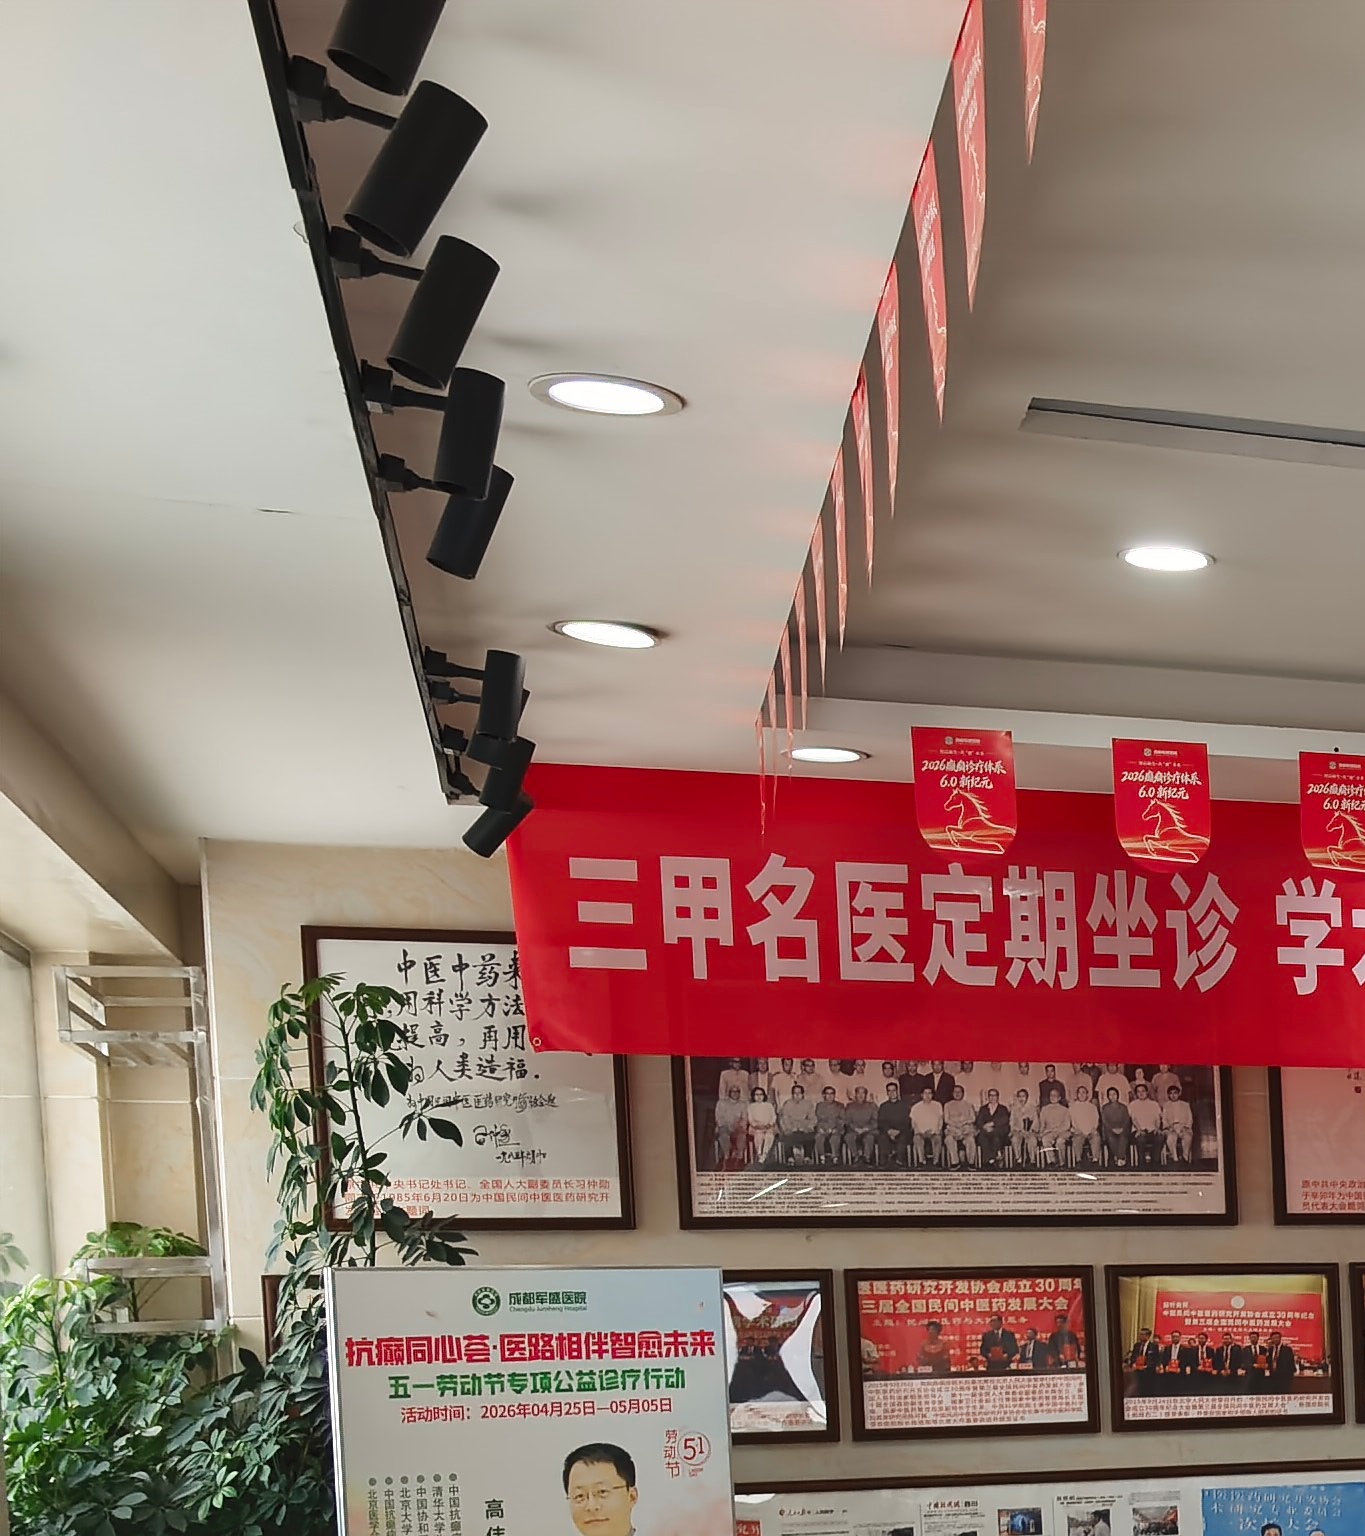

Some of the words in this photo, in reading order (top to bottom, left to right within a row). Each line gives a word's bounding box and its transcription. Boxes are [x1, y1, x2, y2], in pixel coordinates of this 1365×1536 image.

[940, 777, 957, 788] 6.0
[960, 776, 994, 790] 新纪元
[1138, 786, 1154, 798] 6.0
[1156, 786, 1189, 801] 新纪元
[1323, 798, 1339, 811] 6.0
[569, 853, 1239, 993] 三甲名医定期坐诊
[508, 1290, 588, 1306] 成都军盛医院
[861, 1296, 1069, 1314] 三届全国民间中医药发展大会
[345, 1329, 716, 1367] 抗癫同心荟·医路相伴智愈未来
[388, 1367, 686, 1399] 五一劳动节专项公益诊疗行动
[664, 1428, 680, 1479] 劳动节
